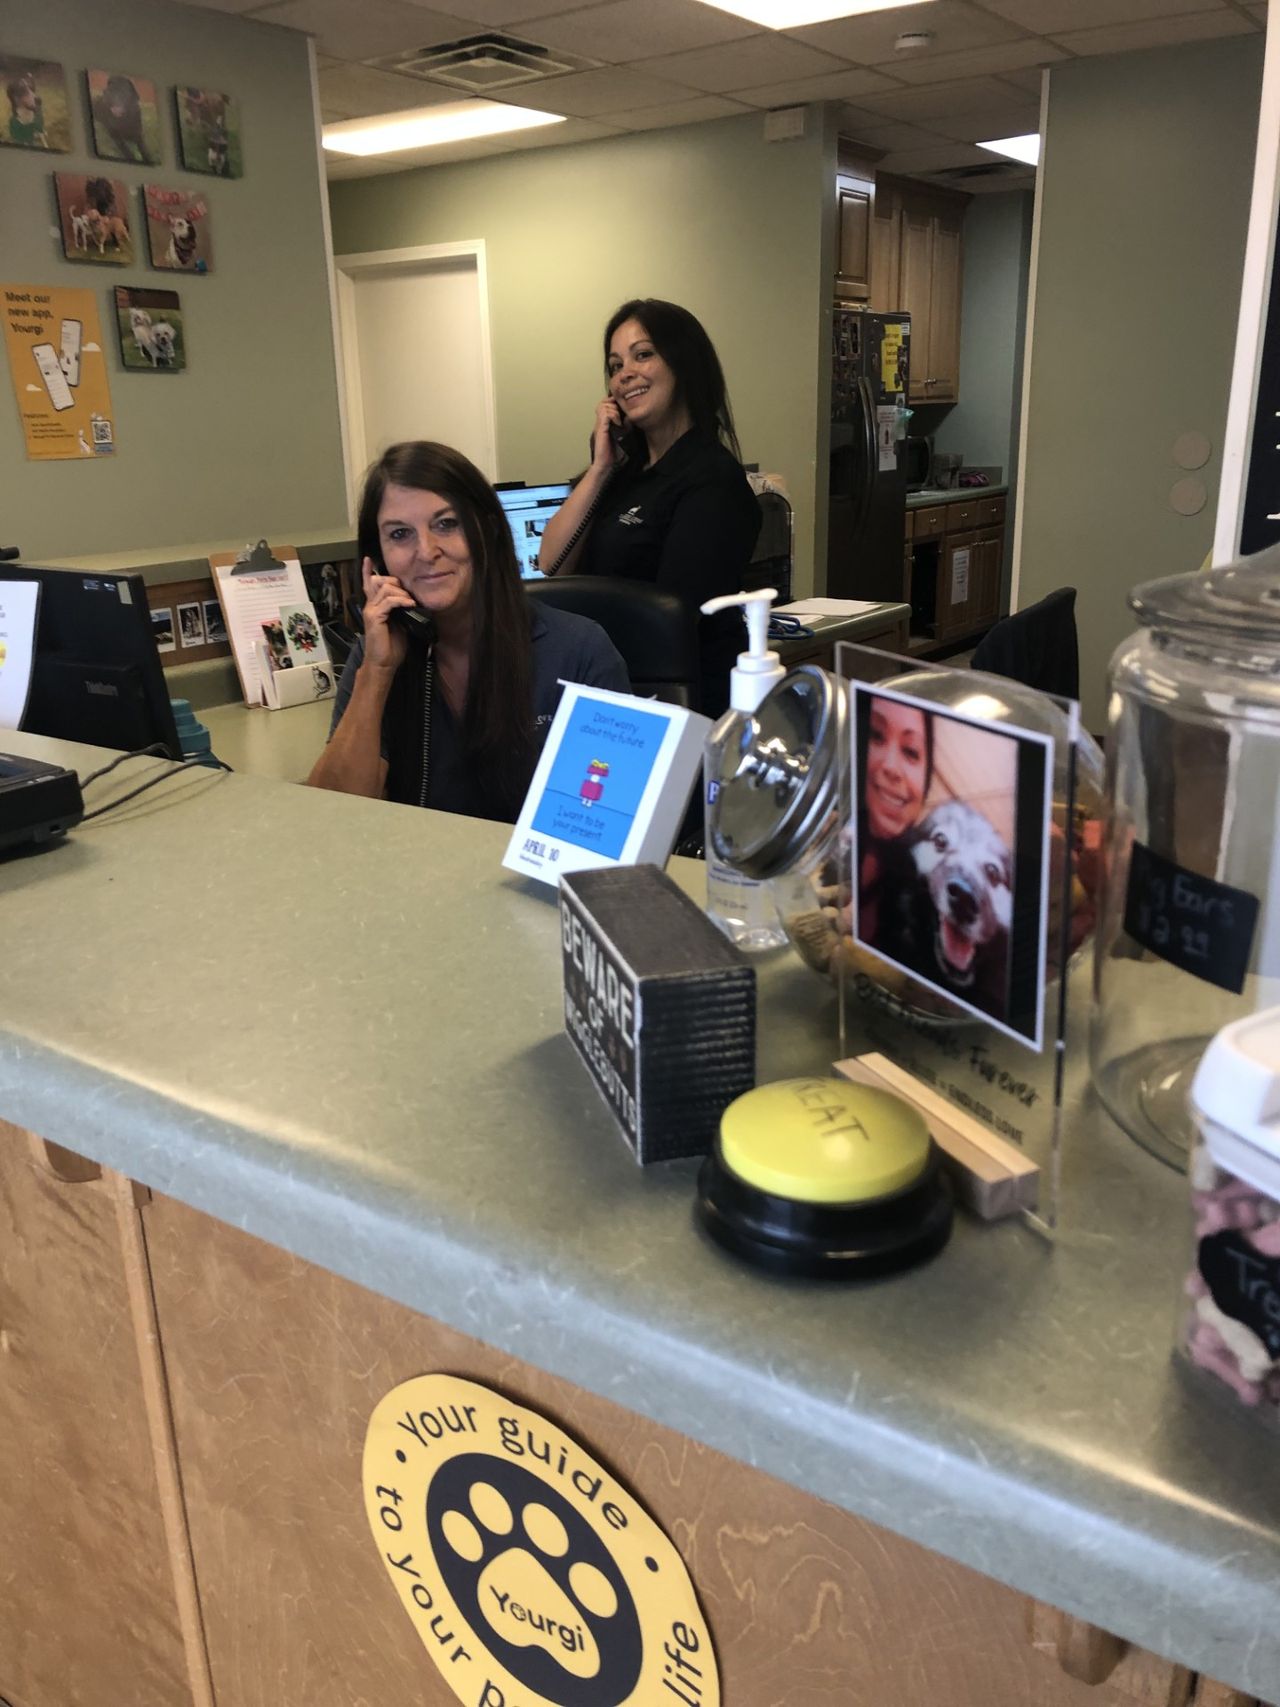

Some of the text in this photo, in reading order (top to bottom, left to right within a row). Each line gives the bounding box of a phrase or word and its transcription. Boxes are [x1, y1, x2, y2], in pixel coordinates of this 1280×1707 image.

[5, 291, 50, 303] Meet our
[8, 308, 29, 317] new
[580, 724, 646, 749] about the future
[615, 721, 640, 736] worry
[552, 817, 603, 842] your present
[557, 804, 606, 830] I want to be
[522, 838, 560, 861] APRIL 10
[562, 900, 634, 1050] BEWARE
[588, 996, 604, 1036] OF
[498, 1416, 628, 1531] guide
[375, 1485, 703, 1707] to your life
[490, 1585, 584, 1652] Yourgi
